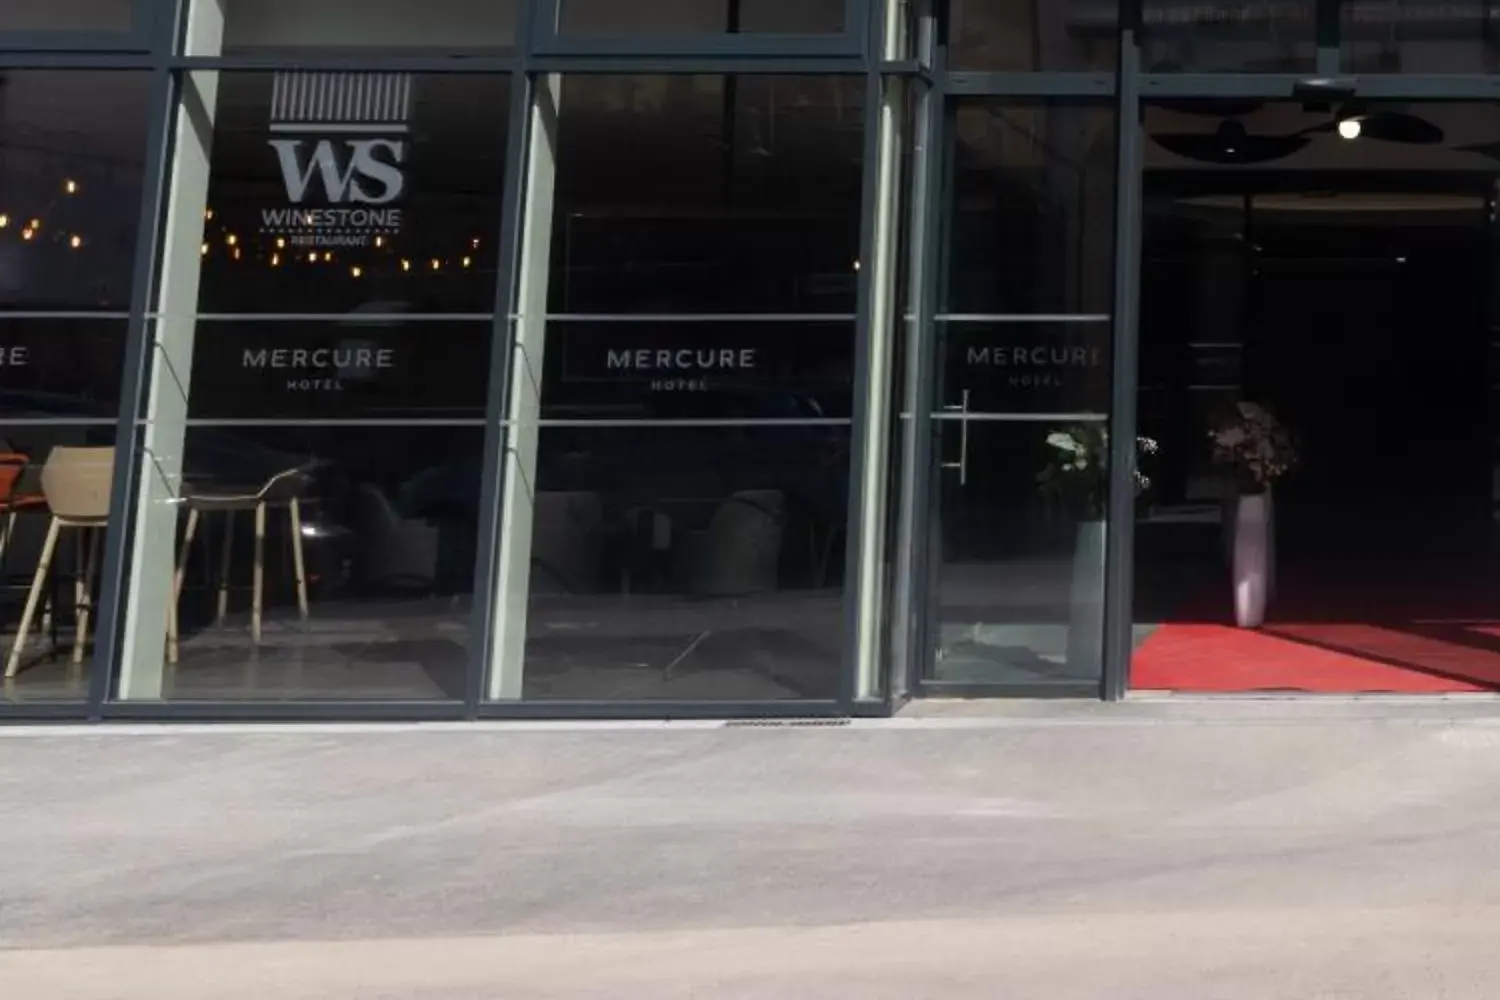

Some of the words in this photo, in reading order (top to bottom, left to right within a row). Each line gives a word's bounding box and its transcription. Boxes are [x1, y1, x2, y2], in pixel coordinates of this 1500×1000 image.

[266, 137, 404, 205] WS
[260, 207, 402, 227] WINESTONE
[242, 348, 396, 368] MERCURE
[607, 348, 756, 369] MERCURE
[286, 379, 345, 391] HOTEL
[651, 379, 709, 391] HOTEL
